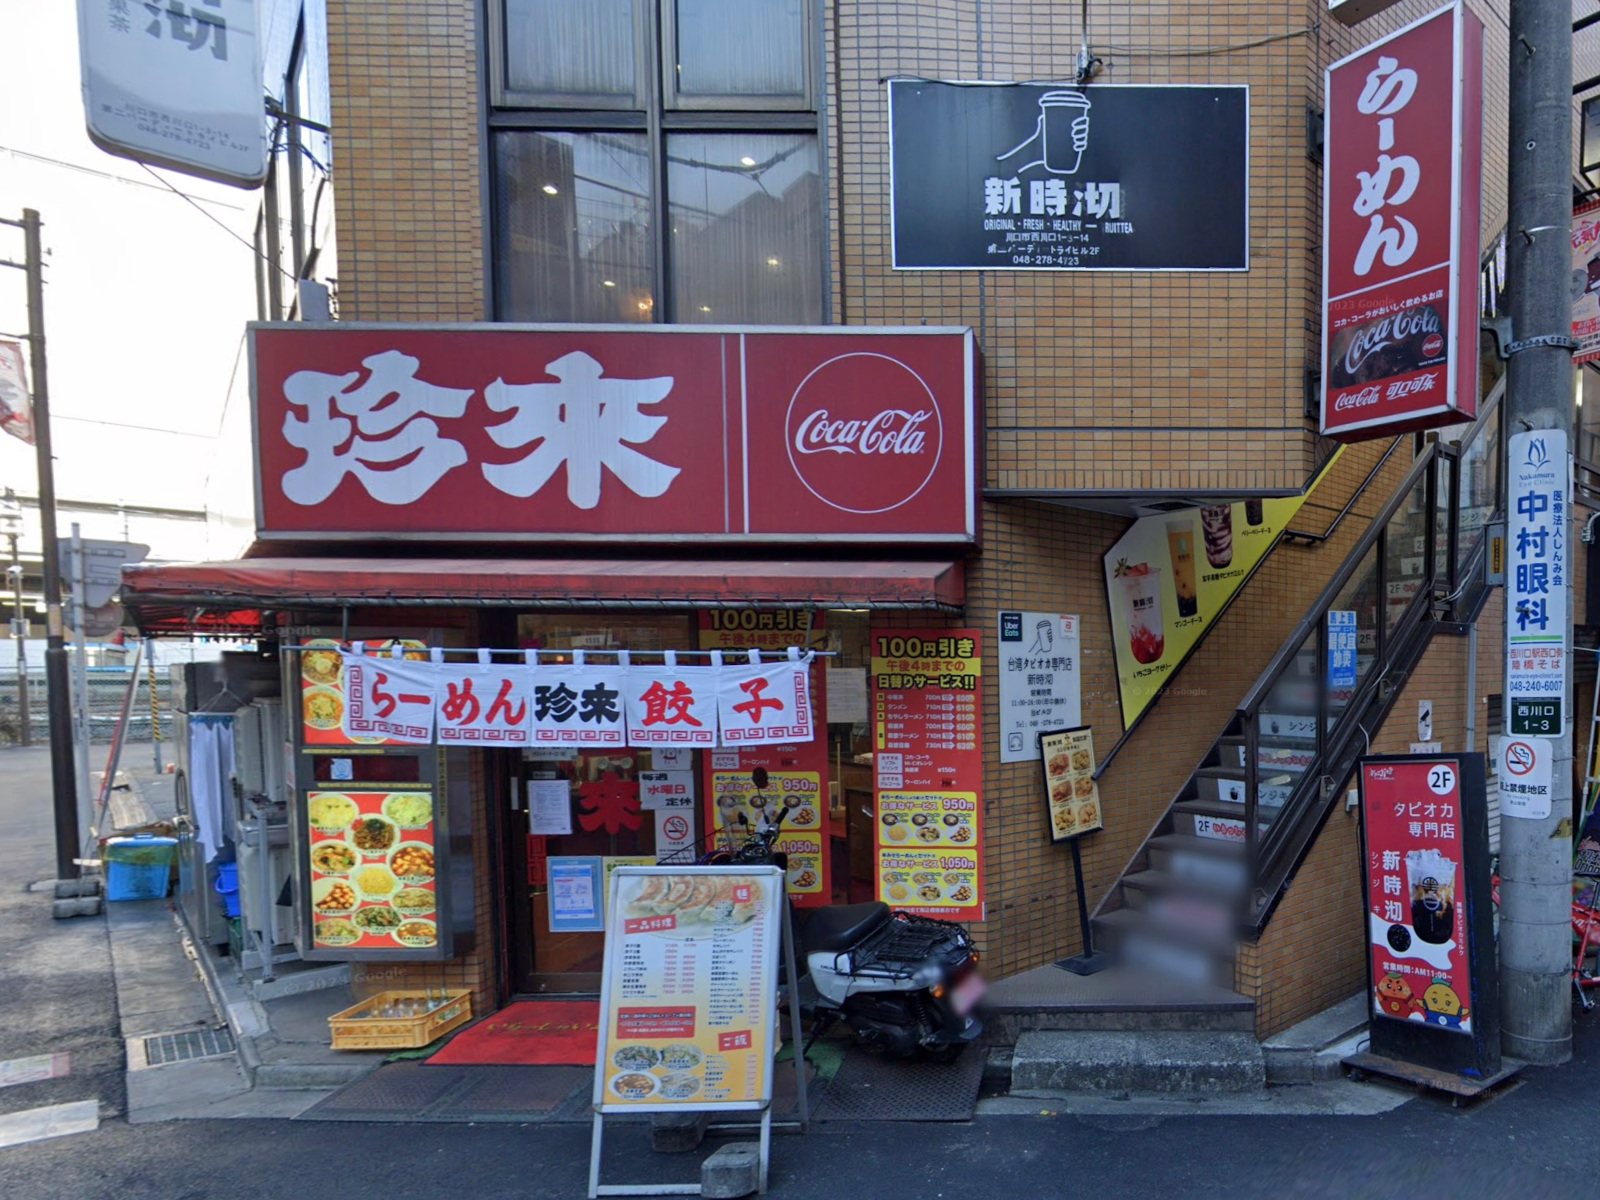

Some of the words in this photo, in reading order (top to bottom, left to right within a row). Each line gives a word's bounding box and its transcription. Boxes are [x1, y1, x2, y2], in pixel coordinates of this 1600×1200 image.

[1353, 55, 1420, 276] らーめん
[984, 219, 1016, 231] ORIGINAL
[1023, 219, 1045, 230] FRESH
[1052, 220, 1082, 231] HEALTHY
[795, 408, 933, 455] Coca-Cola
[1552, 490, 1563, 586] 医療法人しんみ会
[1516, 490, 1550, 631] 中村眼科
[1360, 634, 1370, 643] 2F
[877, 637, 975, 658] 100円引き
[886, 660, 966, 671] 午後4時までの
[1008, 657, 1072, 672] 台湾タピオカ専門店
[1512, 659, 1561, 670] 陸橋そば
[878, 675, 976, 690] 日替りサービス!!
[1510, 681, 1562, 692] 048-240-6007
[1518, 706, 1554, 716] 西川口
[1523, 719, 1550, 731] 1-3
[783, 779, 818, 791] 950円
[1431, 771, 1451, 788] 2F
[647, 784, 686, 795] 水曜日
[665, 797, 692, 806] 定休
[942, 799, 975, 811] 950円
[1394, 801, 1454, 818] タピオカ
[1198, 820, 1210, 832] 2F
[1409, 822, 1455, 839] 専門店
[940, 857, 975, 871] 1,050円
[628, 917, 673, 931] 一品料理
[722, 1036, 749, 1048] ご飯
